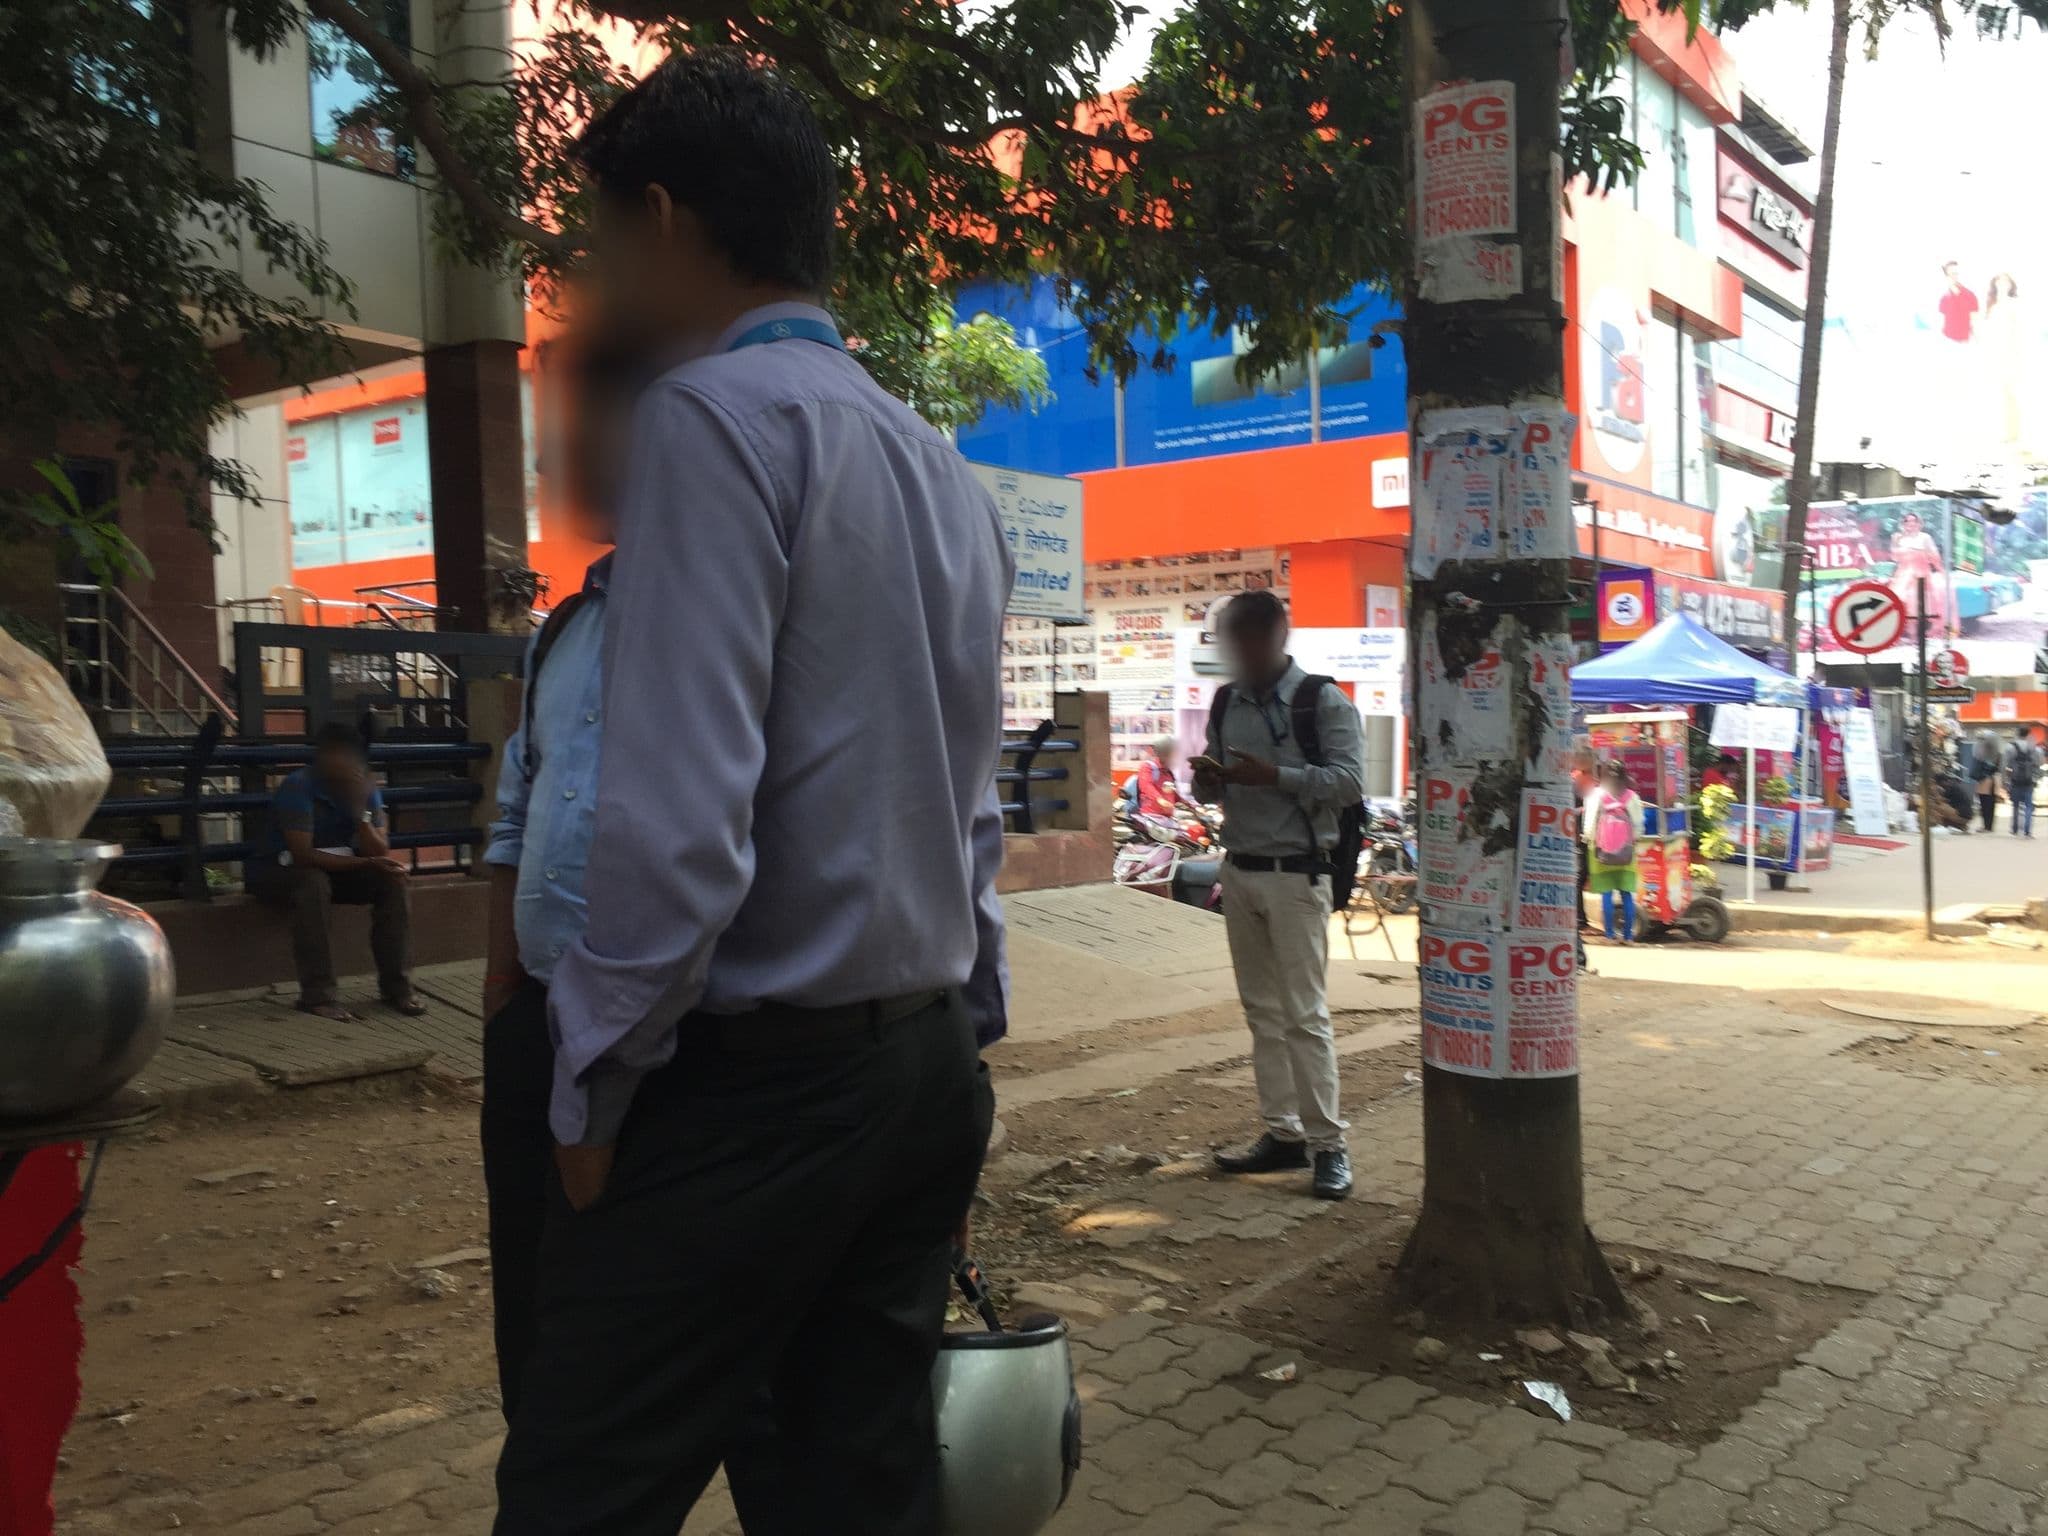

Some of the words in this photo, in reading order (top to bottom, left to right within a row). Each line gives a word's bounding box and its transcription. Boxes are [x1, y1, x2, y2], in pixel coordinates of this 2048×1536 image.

[1423, 96, 1509, 142] PG
[1424, 133, 1510, 160] GENTS
[1016, 567, 1071, 592] mited
[1423, 935, 1491, 974] PG
[1508, 943, 1574, 979] PG
[1423, 966, 1494, 991] GENTS
[1509, 979, 1576, 997] GENTS
